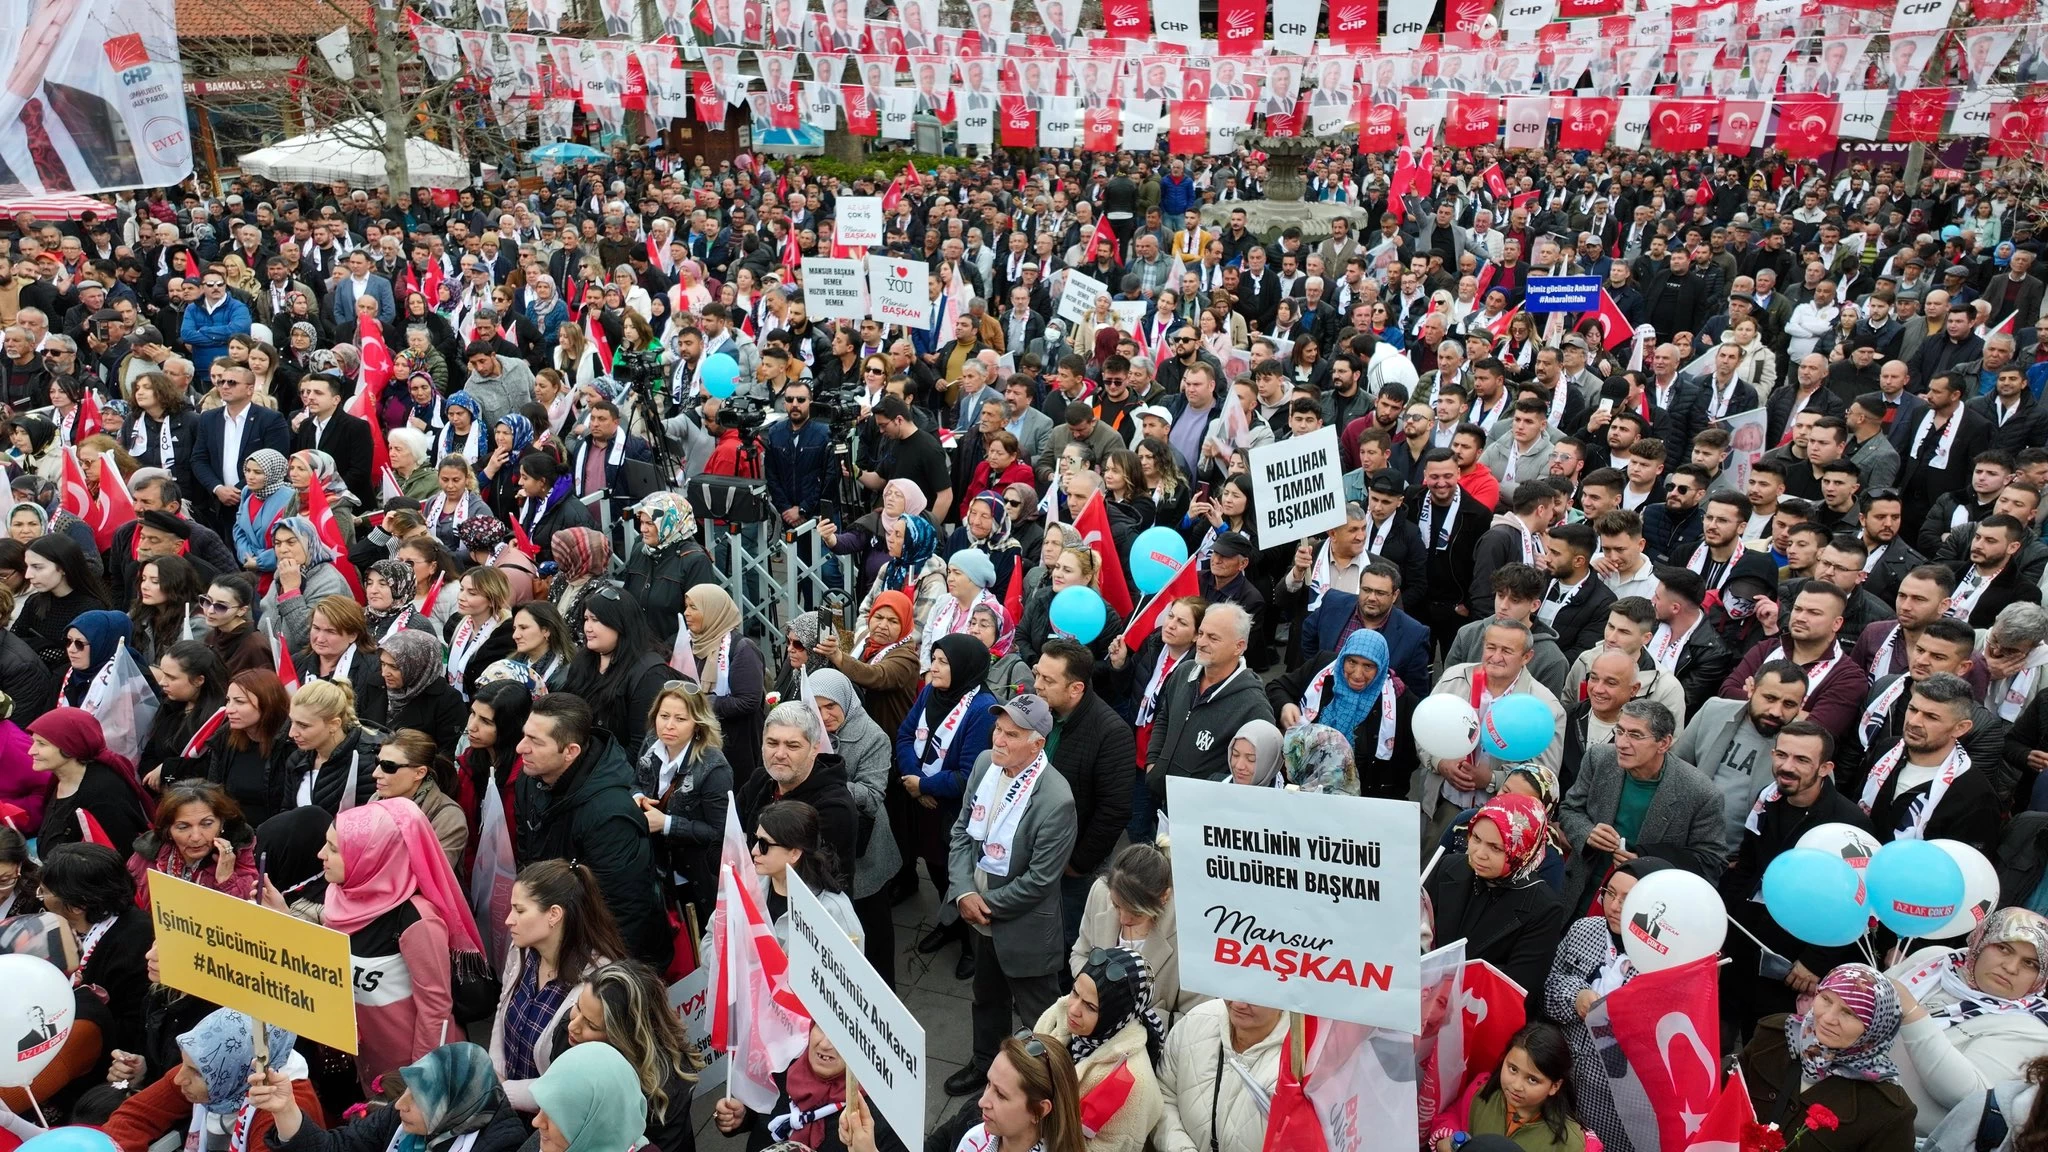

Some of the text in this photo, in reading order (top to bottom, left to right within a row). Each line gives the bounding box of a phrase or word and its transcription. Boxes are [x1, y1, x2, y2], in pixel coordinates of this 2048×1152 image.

[1509, 5, 1542, 16] CHP
[1804, 2, 1818, 12] CHP
[1903, 2, 1941, 15] CHP
[1113, 18, 1140, 27] CHP
[1160, 21, 1189, 32] CHP
[1338, 19, 1367, 31] CHP
[1456, 20, 1481, 34] CHP
[1227, 27, 1255, 39] CHP
[1279, 23, 1307, 34] CHP
[1393, 22, 1423, 34] CHP
[1641, 25, 1660, 35] CHP
[123, 66, 152, 86] CHP
[587, 81, 604, 91] CHP
[626, 85, 642, 94] CHP
[700, 96, 718, 105] CHP
[777, 103, 795, 112] CHP
[811, 103, 831, 114] CHP
[853, 109, 872, 118] CHP
[886, 112, 907, 122] CHP
[1843, 114, 1874, 123] CHP
[1964, 112, 1995, 121] CHP
[965, 117, 987, 127] CHP
[1010, 119, 1031, 129] CHP
[1047, 122, 1070, 132] CHP
[1318, 118, 1342, 131] CHP
[1465, 121, 1489, 131] CHP
[1571, 121, 1597, 131] CHP
[1731, 120, 1758, 130] CHP
[1788, 121, 1816, 131] CHP
[1092, 124, 1112, 133] CHP
[1133, 123, 1154, 133] CHP
[1179, 126, 1201, 135] CHP
[1273, 129, 1293, 137] CHP
[1368, 125, 1392, 135] CHP
[1513, 123, 1540, 133] CHP
[1678, 123, 1702, 133] CHP
[152, 131, 184, 152] EVET
[848, 212, 862, 220] ÇOK
[844, 232, 876, 241] BAŞKAN
[809, 267, 855, 279] MANSUR BAŞKAN
[824, 278, 842, 286] DEMEK
[885, 279, 913, 294] YOU
[809, 288, 827, 296] HUZUR
[836, 289, 858, 297] BEREKET
[1527, 283, 1598, 295] İşimiz gücümüz Ankara!
[1539, 294, 1587, 304] #Ankaraİttifakı
[882, 305, 921, 319] BAŞKAN
[1266, 448, 1328, 483] NALLIHAN
[1274, 472, 1325, 504] TAMAM
[1267, 492, 1335, 530] BAŞKANIM
[1879, 686, 1898, 712] BAŞKAN
[1009, 702, 1032, 716] adidas
[1203, 825, 1381, 868] EMEKLİNİN YÜZÜNÜ
[1206, 855, 1380, 903] GÜLDÜREN BAŞKAN
[1896, 903, 1908, 912] AZ
[1203, 905, 1334, 952] Mansur
[156, 901, 344, 988] İşimiz gücümüz Ankara!
[1213, 936, 1394, 992] BAŞKAN
[194, 951, 316, 1014] #Ankaraİttifakı
[790, 896, 918, 1080] İşimiz gücümüz Ankara!
[810, 966, 894, 1091] #Ankaraİttifakı
[21, 1050, 32, 1060] AZ
